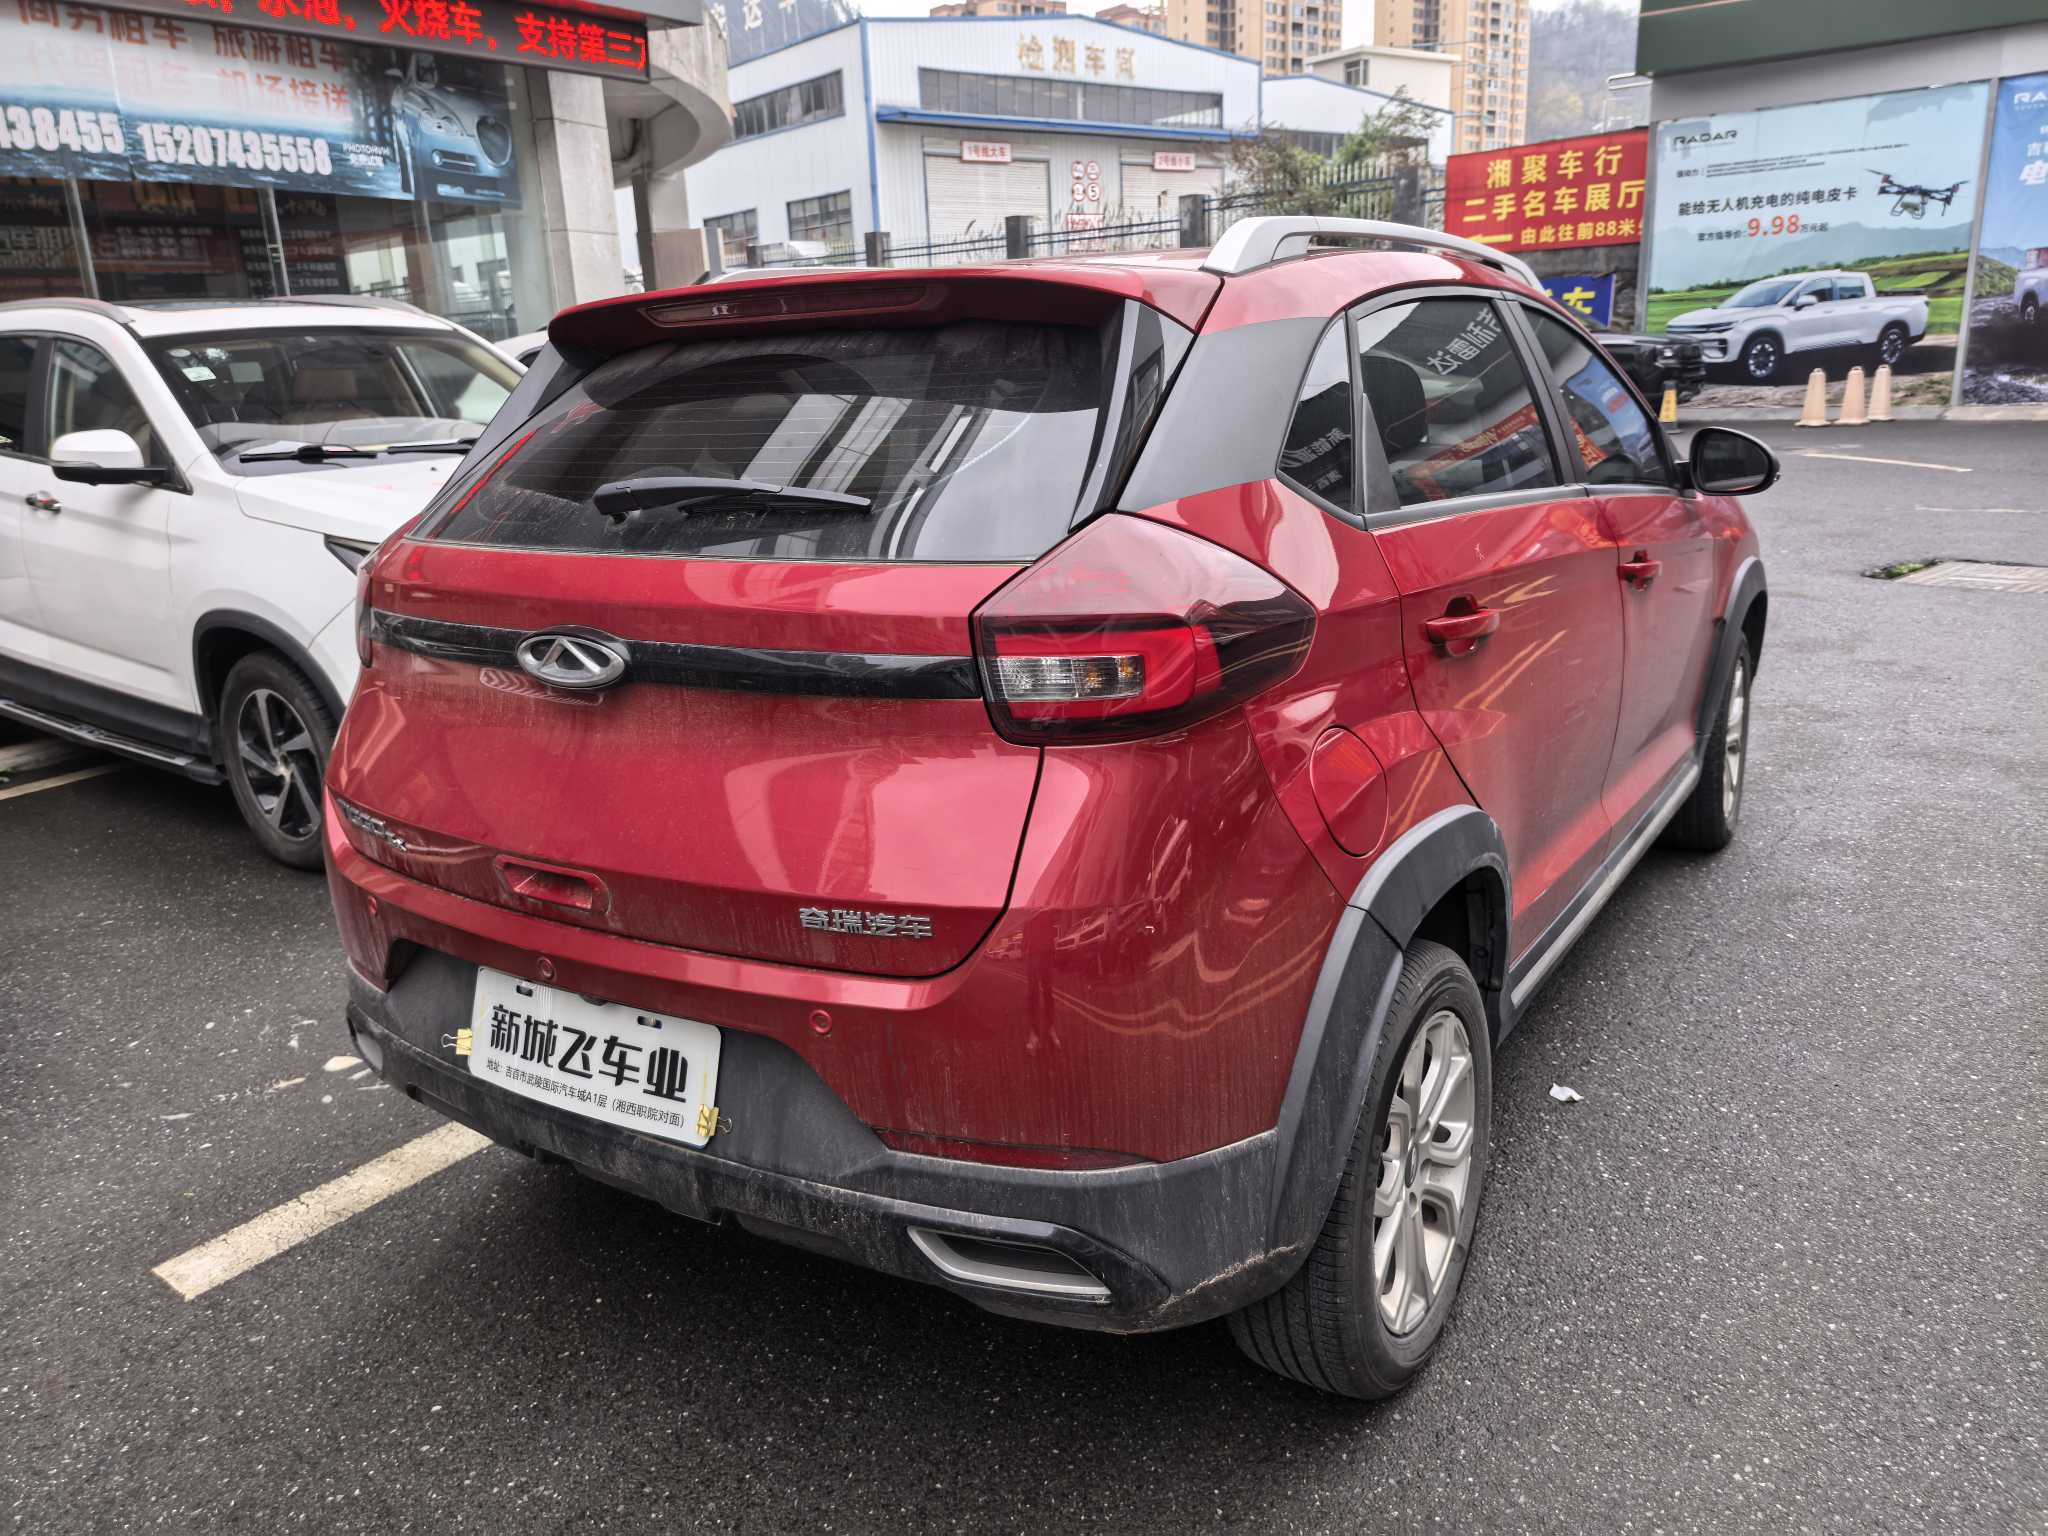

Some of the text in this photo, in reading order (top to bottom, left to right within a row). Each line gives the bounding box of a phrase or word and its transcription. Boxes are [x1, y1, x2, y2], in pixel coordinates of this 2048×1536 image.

[137, 122, 333, 176] 15207435558
[1673, 130, 1738, 146] RADAR
[1486, 145, 1623, 189] 湘聚车行
[1463, 179, 1647, 223] 二手名车展厅
[1678, 186, 1858, 217] 能给无人机充电的纯电皮卡
[799, 906, 933, 939] 奇瑞汽车
[490, 1003, 689, 1104] 新城飞车业
